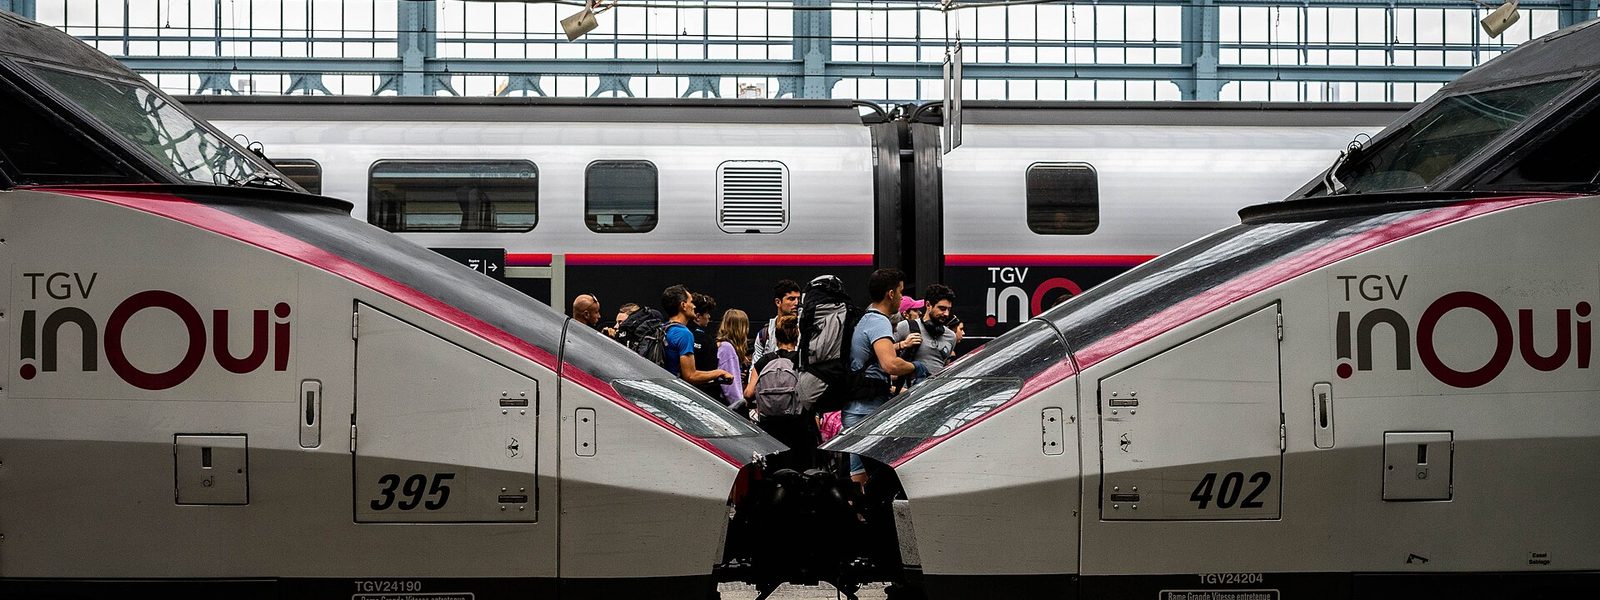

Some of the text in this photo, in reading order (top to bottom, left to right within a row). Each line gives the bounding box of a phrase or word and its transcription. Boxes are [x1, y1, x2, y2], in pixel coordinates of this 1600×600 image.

[23, 272, 98, 300] TGV
[988, 267, 1029, 283] TGV
[1336, 275, 1409, 301] TGV
[370, 473, 455, 511] 395
[1189, 471, 1272, 509] 402
[354, 580, 422, 592] TGV24190
[1198, 573, 1264, 584] TGV24204
